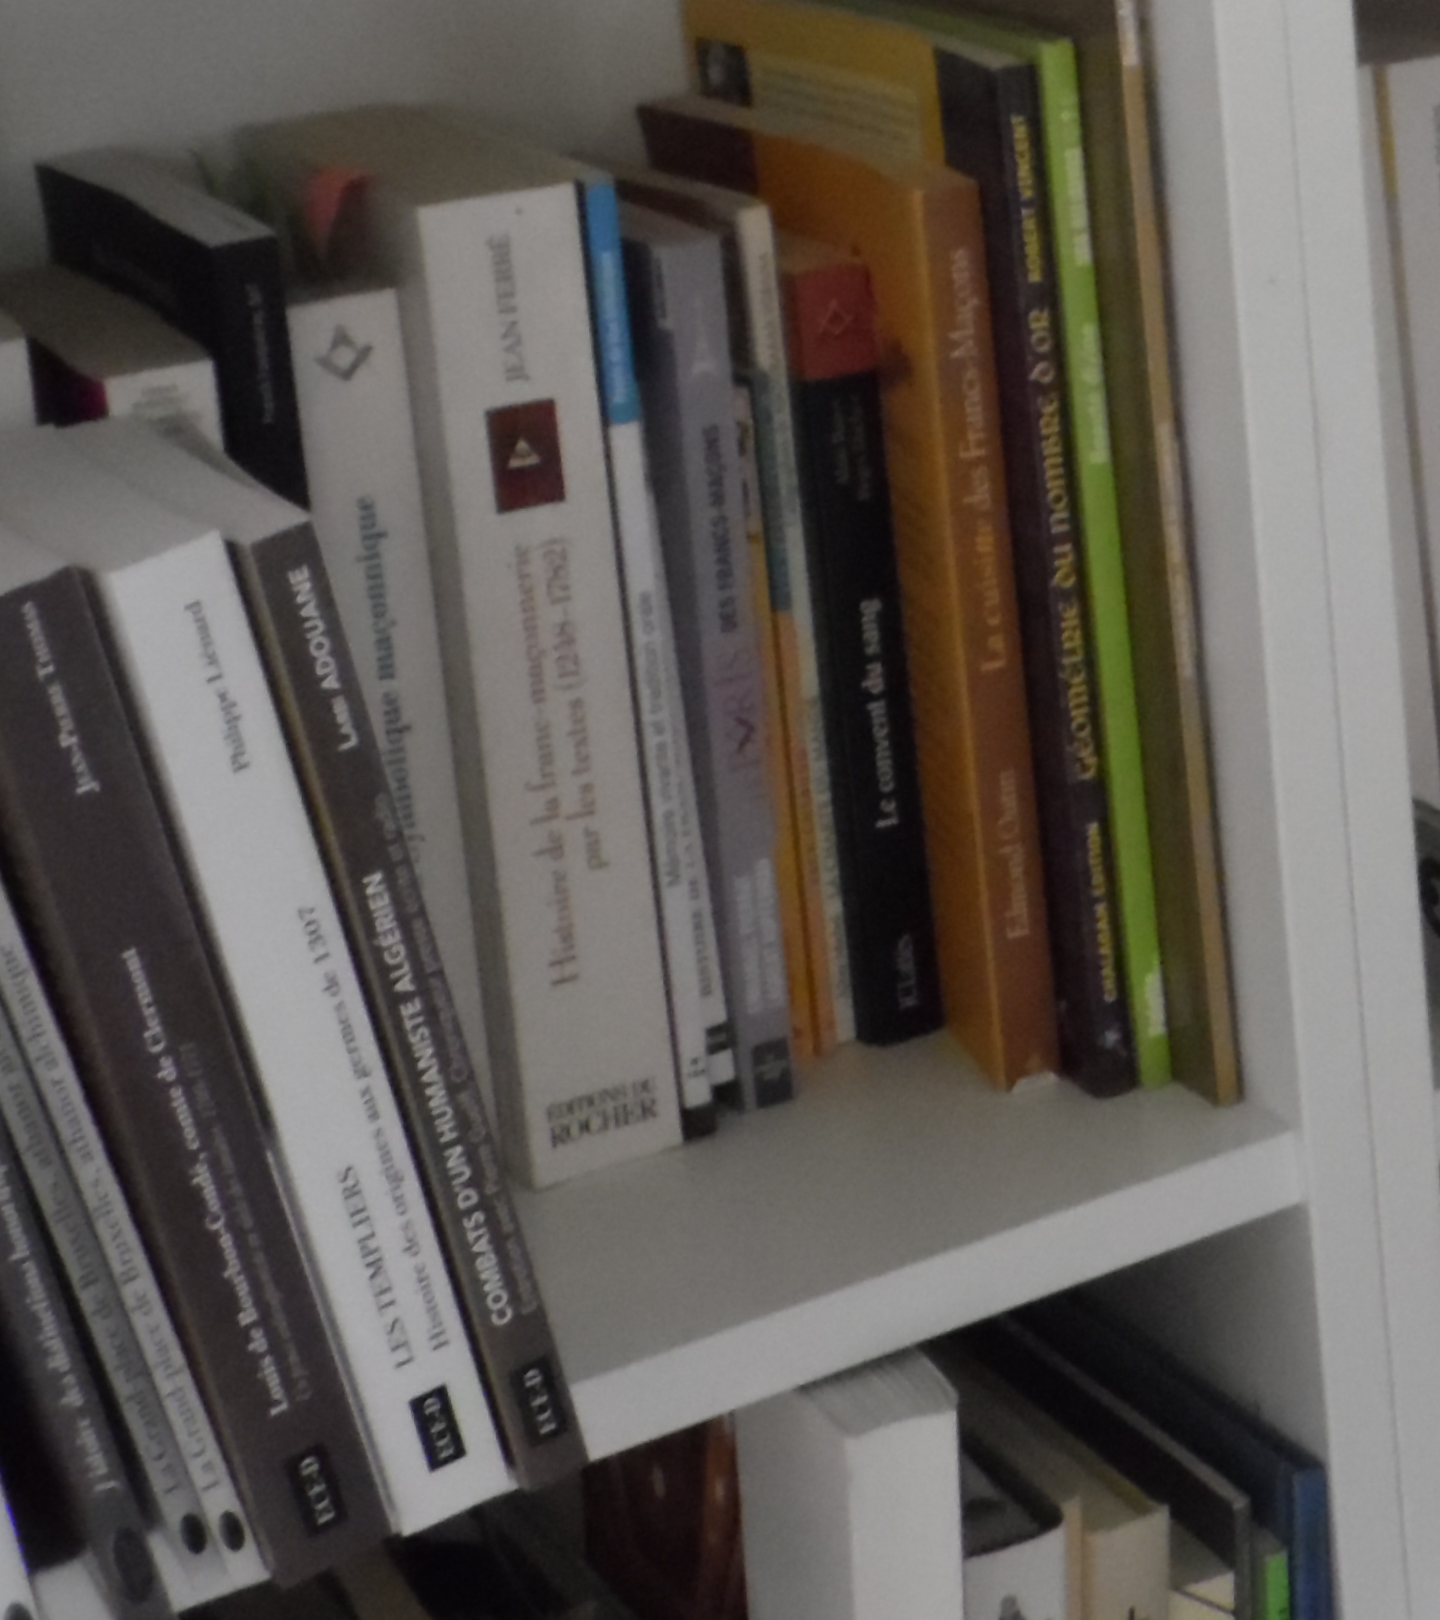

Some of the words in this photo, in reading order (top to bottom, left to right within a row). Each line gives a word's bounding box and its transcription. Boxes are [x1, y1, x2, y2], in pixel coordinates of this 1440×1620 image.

[289, 567, 341, 690] ADOUANE
[856, 598, 884, 656] sang
[859, 662, 886, 694] du
[530, 797, 561, 825] la
[875, 799, 899, 828] Le
[533, 831, 565, 861] de
[363, 871, 416, 993] ALGÉRIEN
[551, 869, 581, 987] Histoire
[401, 998, 458, 1141] HUMANISTE
[444, 1147, 478, 1206] D'UN
[463, 1211, 512, 1326] COMBATS
